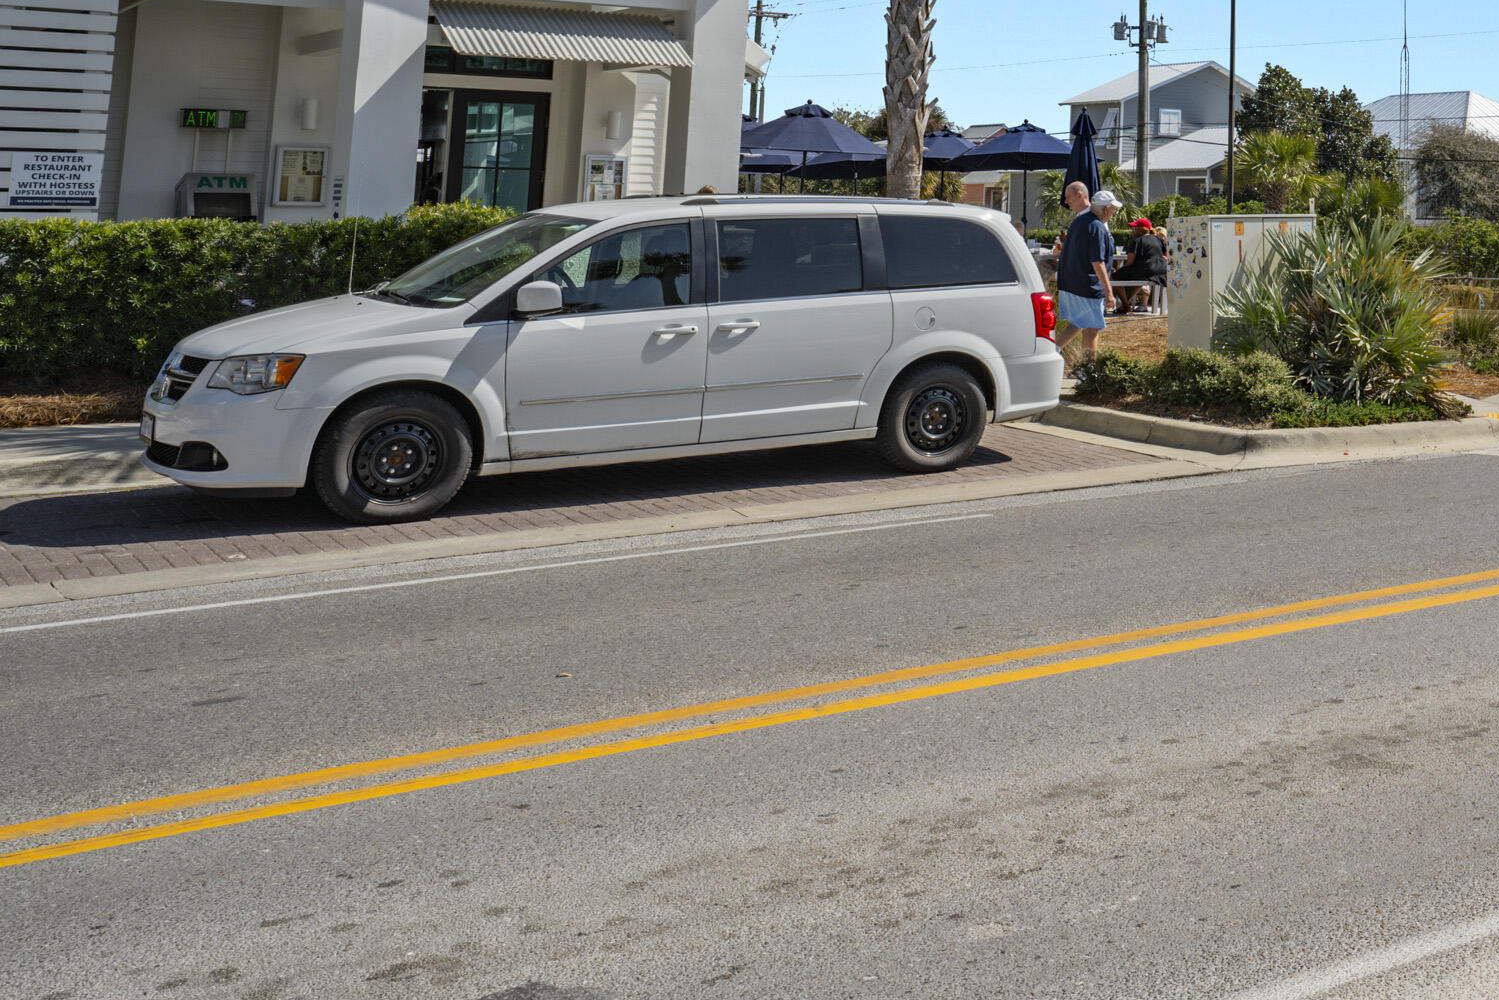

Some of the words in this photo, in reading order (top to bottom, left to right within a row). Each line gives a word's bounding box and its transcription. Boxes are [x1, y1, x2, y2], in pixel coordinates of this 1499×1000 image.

[185, 111, 216, 127] ATM
[51, 155, 84, 163] ENTER
[23, 164, 93, 172] RESTAURANT
[49, 182, 95, 190] HOSTESS
[197, 176, 248, 189] ATM
